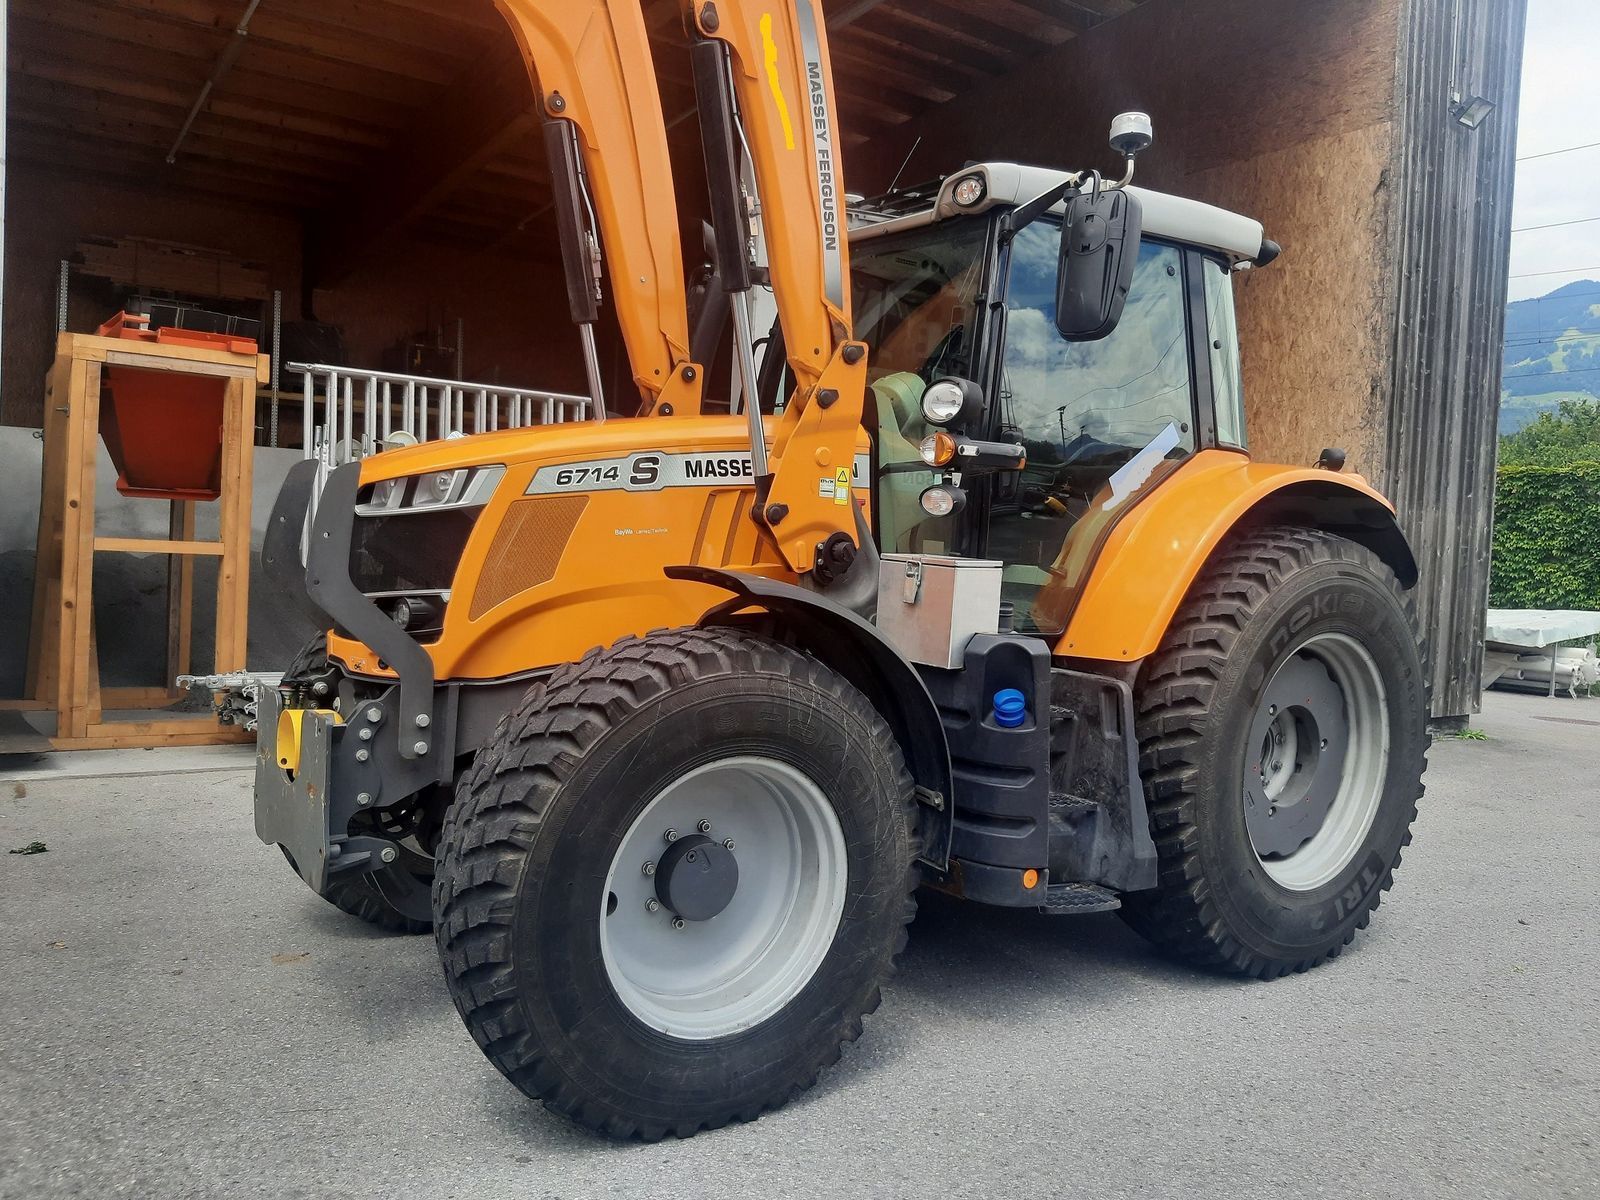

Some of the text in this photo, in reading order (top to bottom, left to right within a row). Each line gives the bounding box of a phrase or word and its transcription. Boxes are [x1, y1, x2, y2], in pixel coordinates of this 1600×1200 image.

[807, 61, 836, 251] MASSEY FERGUSON
[556, 456, 753, 485] 6714 S MASSE
